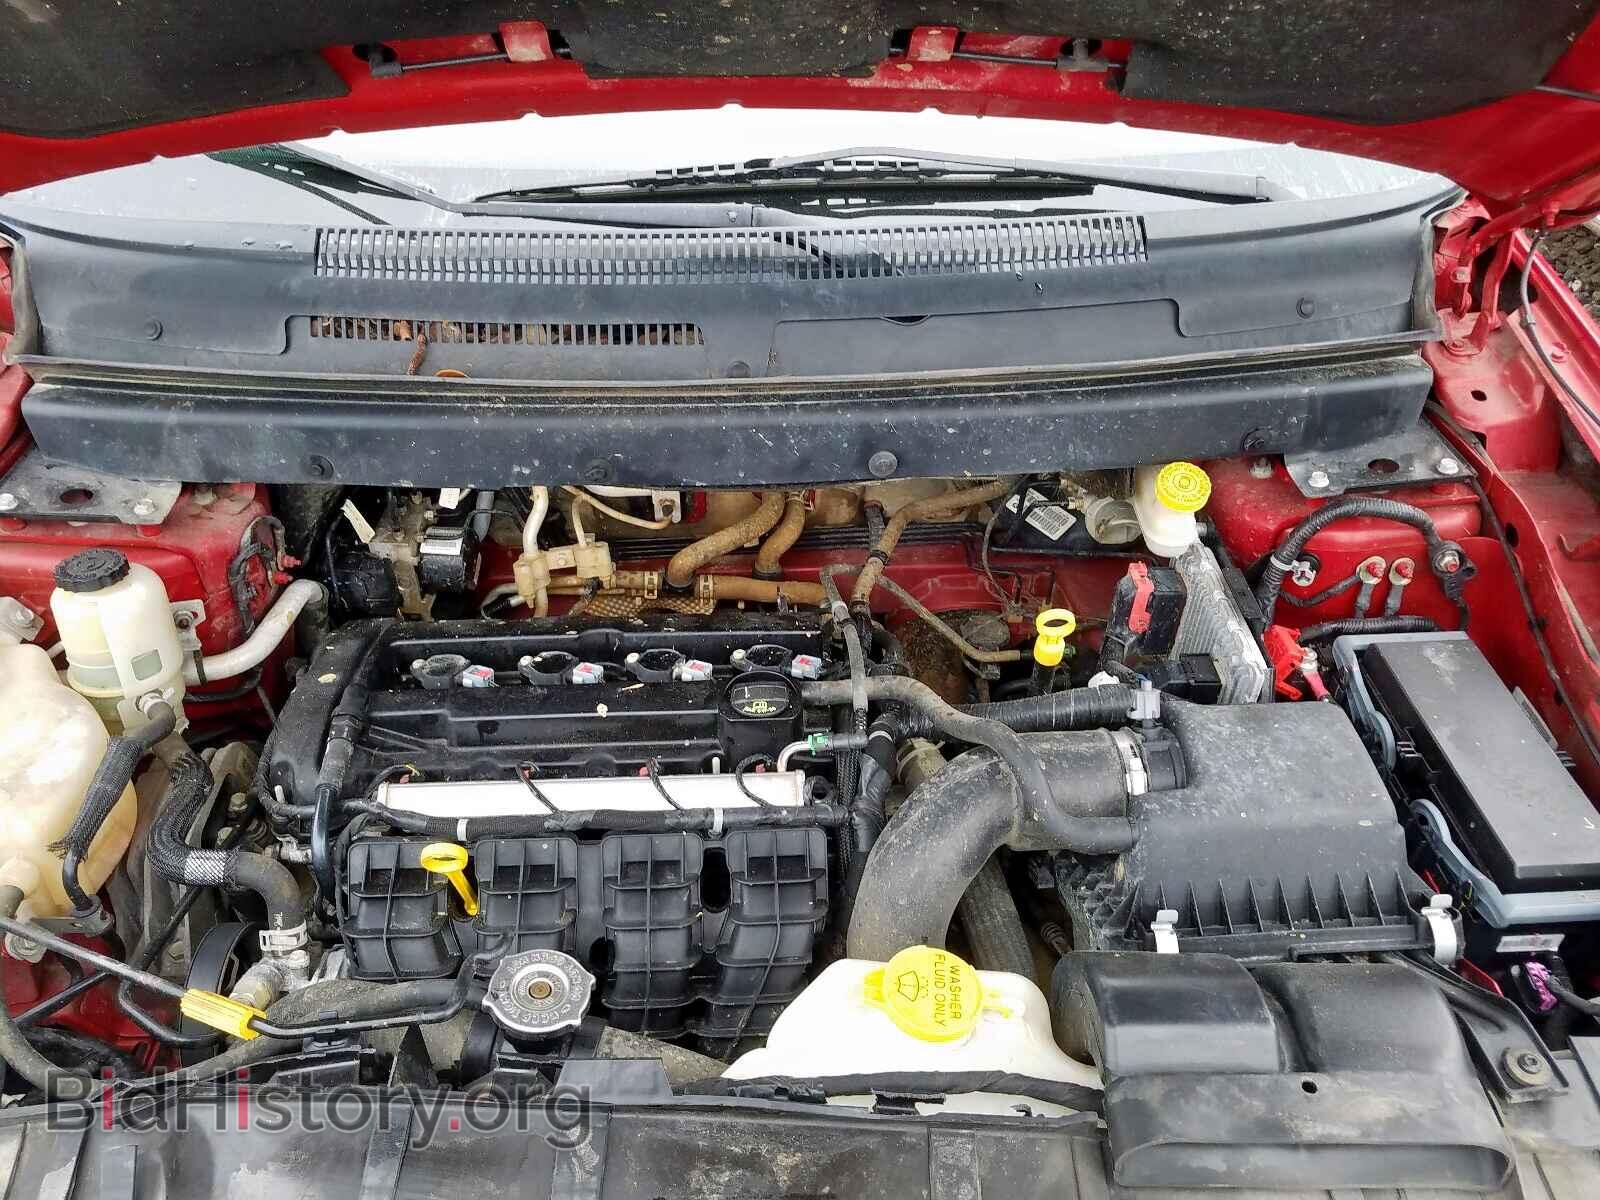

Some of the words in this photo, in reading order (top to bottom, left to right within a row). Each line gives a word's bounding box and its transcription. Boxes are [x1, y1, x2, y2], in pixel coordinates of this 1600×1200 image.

[934, 953, 946, 990] FLUID
[934, 993, 946, 1027] ONLY
[949, 965, 962, 1019] WASHER
